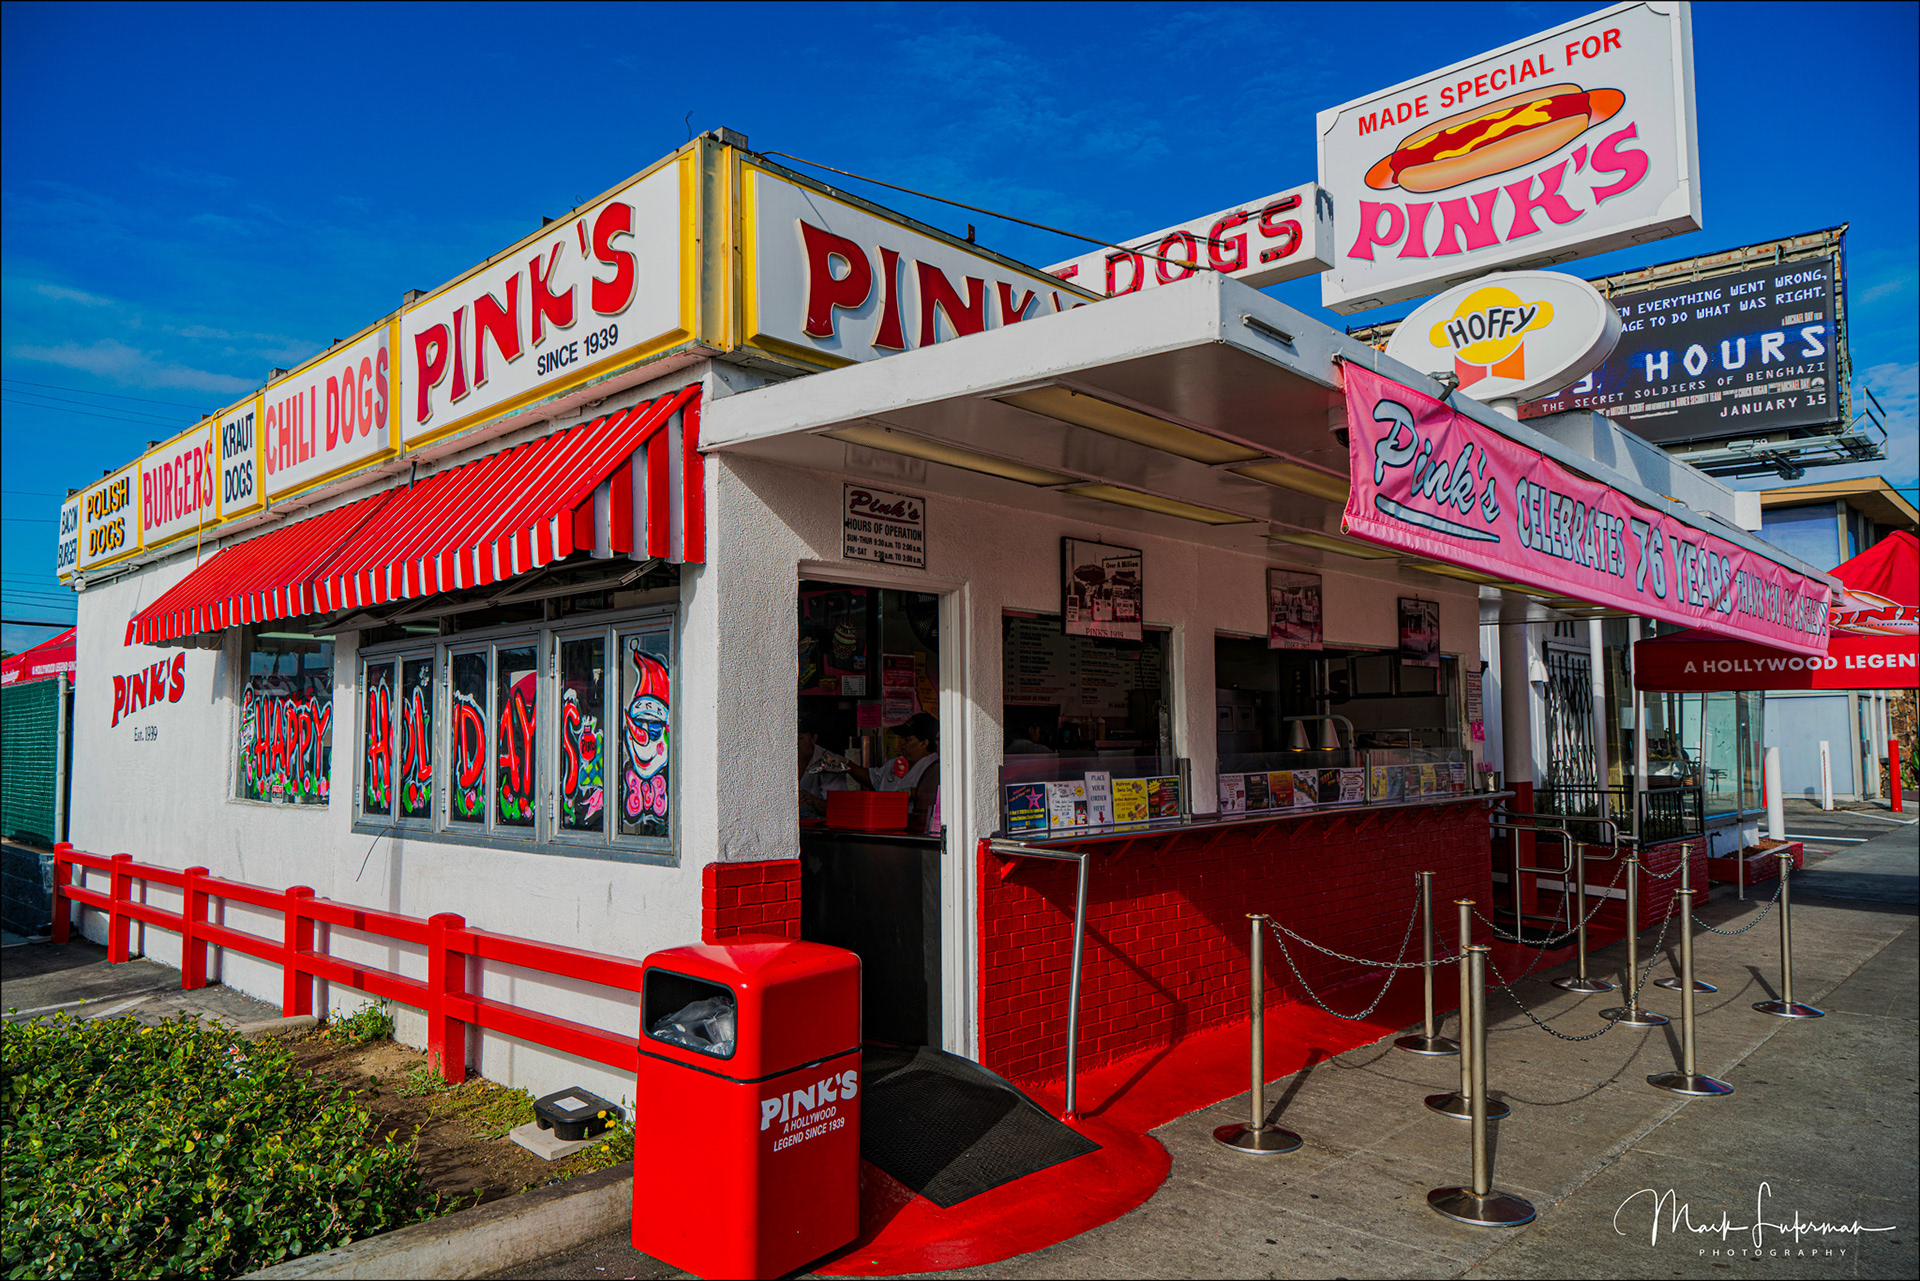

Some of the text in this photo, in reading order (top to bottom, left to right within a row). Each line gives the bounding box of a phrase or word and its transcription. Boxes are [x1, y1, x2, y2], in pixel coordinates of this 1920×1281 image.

[1358, 28, 1622, 136] MADE SPECIAL FOR
[1347, 120, 1650, 262] PINK'S
[1105, 193, 1303, 297] DOGS
[414, 201, 639, 424] PINK'S
[1638, 288, 1722, 315] EVERYTHING
[1730, 280, 1766, 297] WENT
[1774, 268, 1827, 288] WRONG,
[1650, 315, 1666, 328] TO
[1671, 311, 1688, 325] DO
[1696, 303, 1731, 320] WHAT
[1739, 297, 1767, 311] WAS
[1775, 285, 1827, 305] RIGHT.
[537, 323, 619, 376] SINCE 1939
[1445, 304, 1537, 348] HOFFY
[1644, 325, 1827, 383] HOURS
[265, 346, 389, 475] CHILI DOGS
[1542, 401, 1565, 413] THE
[1574, 392, 1625, 408] SECRET
[1634, 380, 1706, 399] SOLDIERS
[1717, 375, 1734, 386] OF
[1746, 361, 1826, 383] BENGHAZI
[1720, 393, 1827, 418] JANUARY 15
[222, 411, 254, 460] KRAUT
[86, 476, 130, 523] POLISH
[143, 440, 213, 531] BURGERS
[224, 460, 253, 504] DOGS
[849, 490, 920, 520] Pink's
[61, 503, 79, 536] BACON
[847, 518, 922, 541] HOURS OF OPERATION
[1372, 398, 1501, 524] Pink's
[1515, 476, 1627, 579] CELEBRATES
[1630, 515, 1666, 600] 76
[1669, 534, 1733, 615] YEARS
[57, 537, 78, 569] BURGER
[88, 516, 125, 556] DOGS
[1684, 653, 1919, 673] A HOLLYWOOD LEGEN
[111, 651, 186, 728] PINK'S
[255, 697, 332, 779] HAPPY
[760, 1070, 858, 1132] PINK'S
[783, 1106, 837, 1134] A HOLLYWOOD
[773, 1117, 845, 1152] LEGEND SINCE 1939
